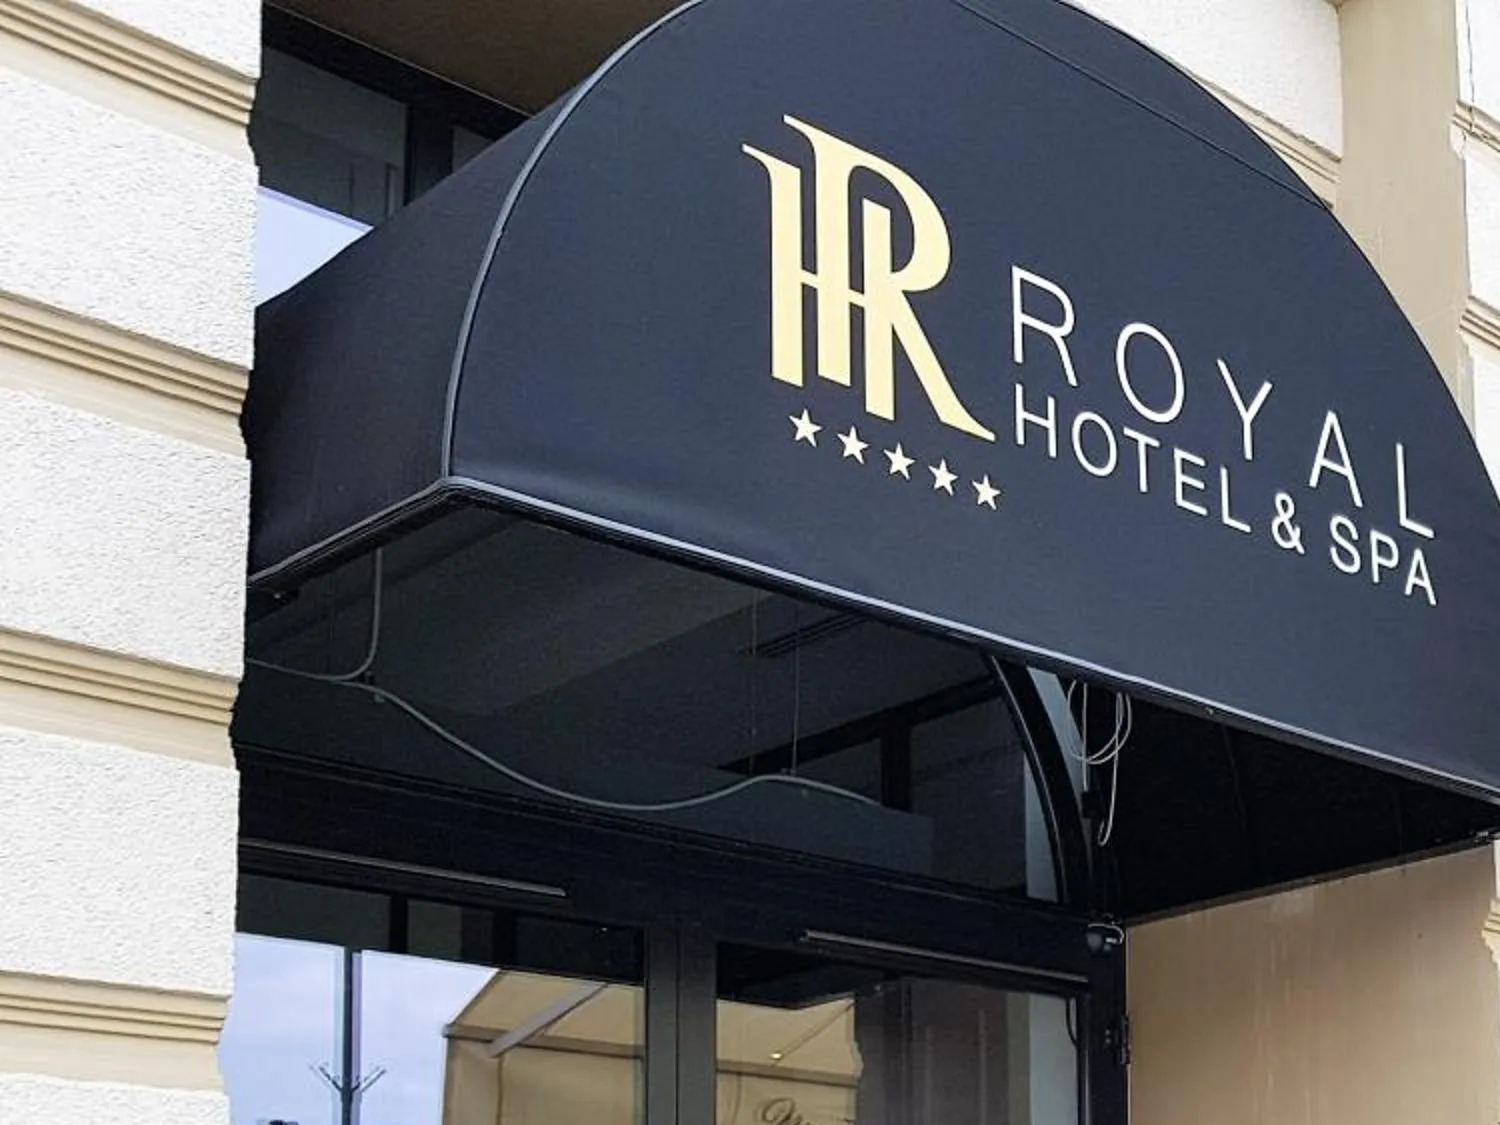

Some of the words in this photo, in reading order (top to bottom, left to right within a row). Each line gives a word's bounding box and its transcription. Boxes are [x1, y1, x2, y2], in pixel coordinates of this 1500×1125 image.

[1012, 265, 1432, 539] ROYAL
[1015, 384, 1250, 534] HOTEL
[1272, 492, 1304, 553] &
[1330, 515, 1436, 604] SPA
